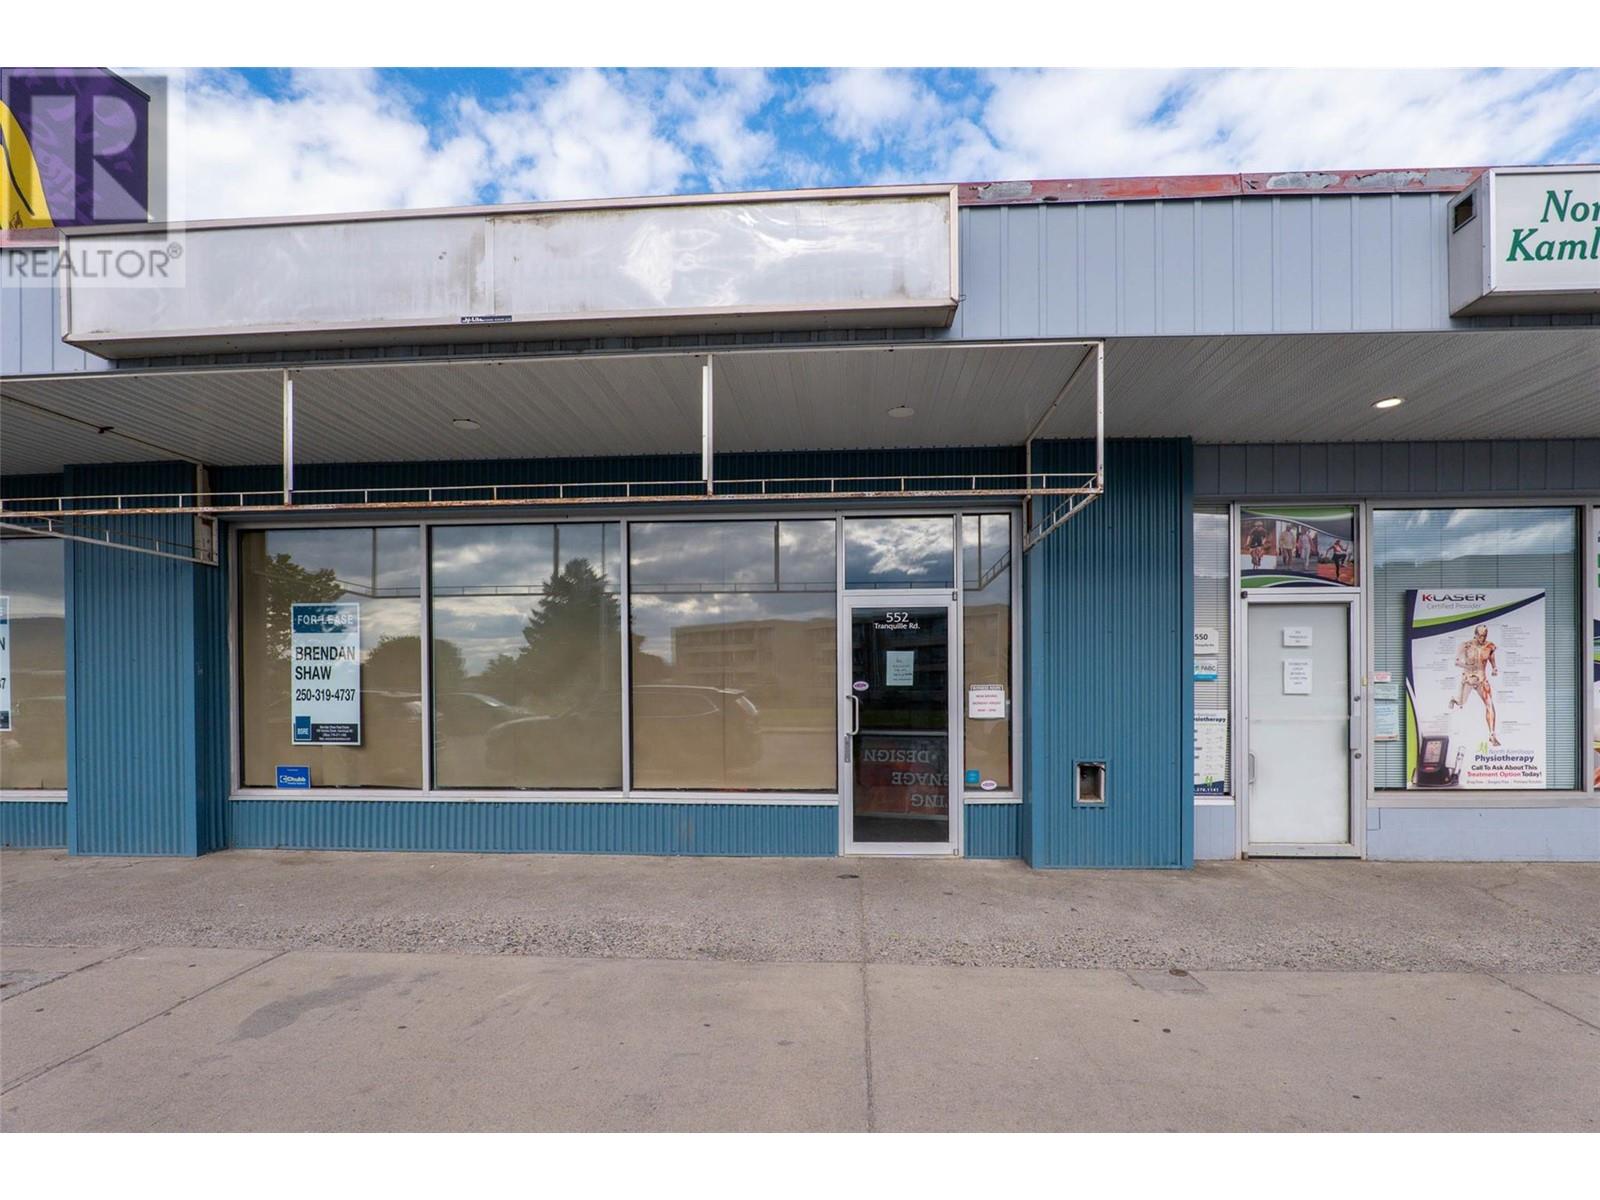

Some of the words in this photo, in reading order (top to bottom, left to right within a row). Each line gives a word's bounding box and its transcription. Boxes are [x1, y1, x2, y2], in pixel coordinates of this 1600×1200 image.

[1540, 189, 1600, 223] Nor
[1505, 225, 1600, 262] Kaml
[297, 614, 318, 625] FOR
[321, 614, 354, 625] LEASE
[886, 612, 910, 623] 552
[874, 622, 908, 631] Tranquille
[909, 622, 921, 630] Rd.
[1194, 633, 1209, 641] 550
[295, 646, 356, 661] BRENDAN
[295, 665, 332, 680] SHAW
[295, 688, 356, 701] 250-319-4737
[864, 749, 930, 763] DESIGN
[1474, 754, 1535, 763] Physiotherapy
